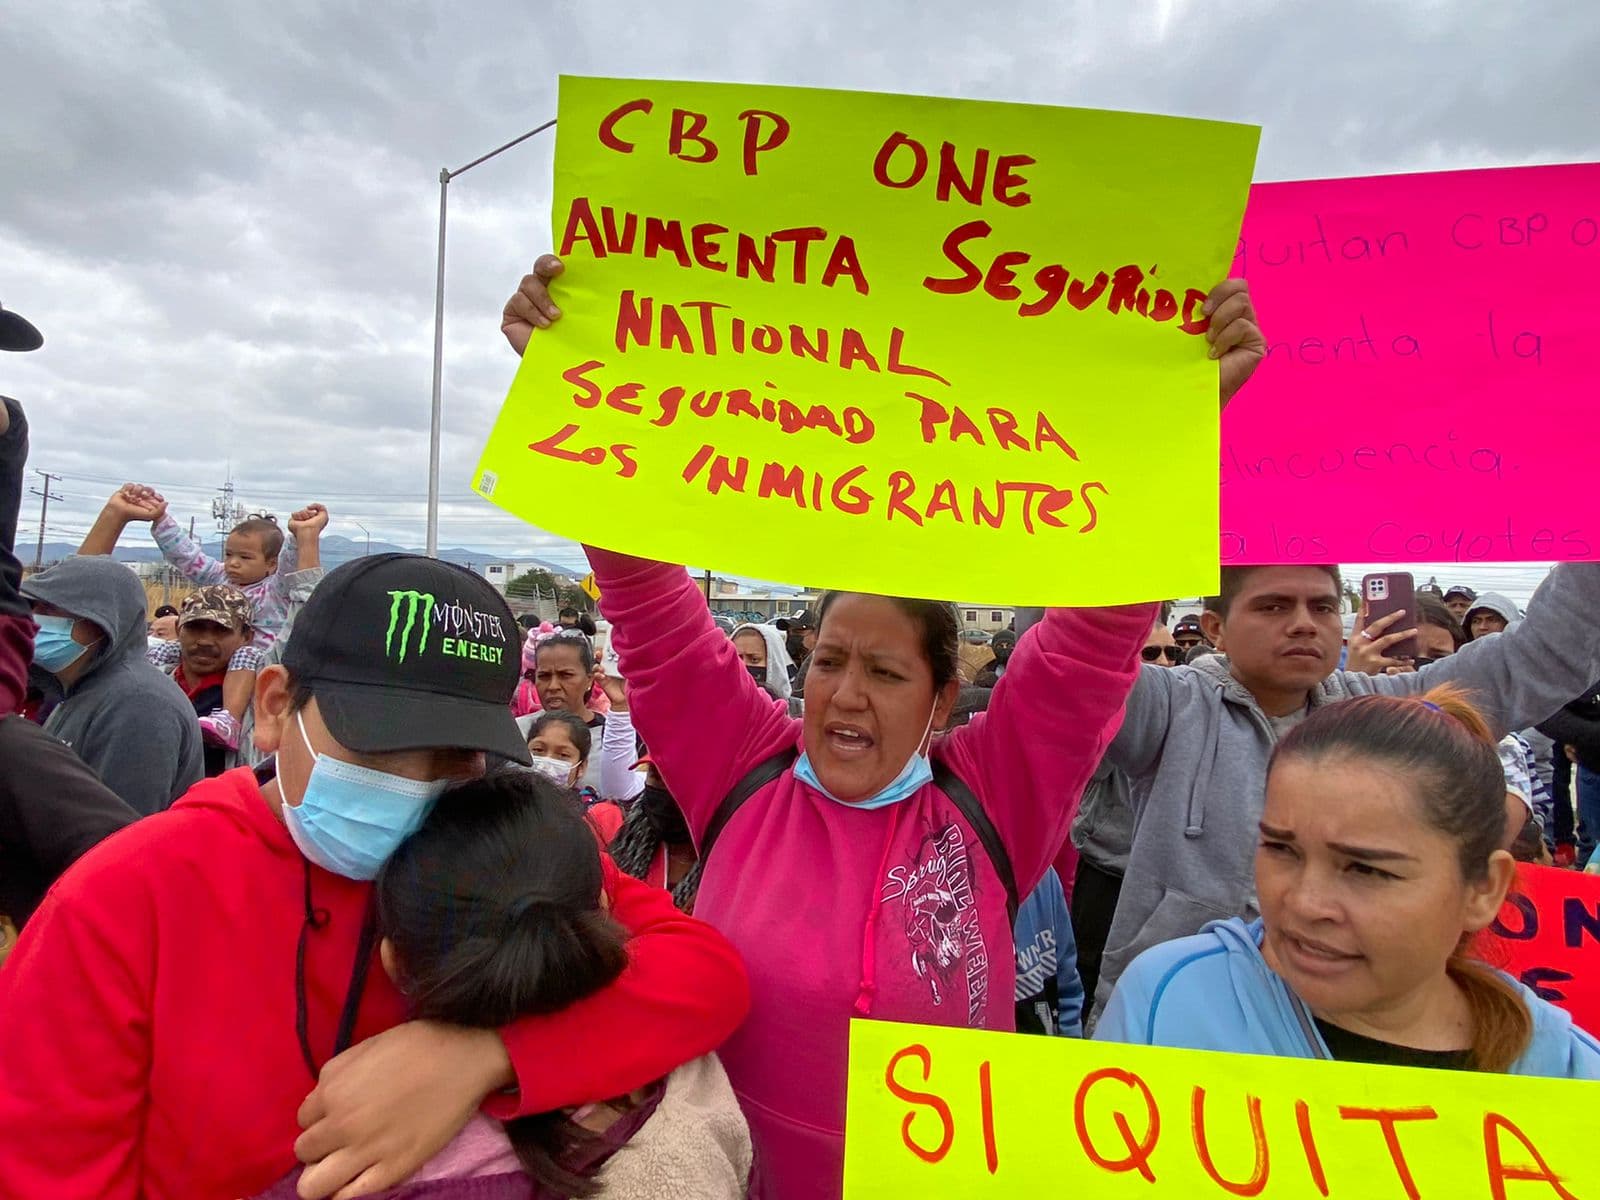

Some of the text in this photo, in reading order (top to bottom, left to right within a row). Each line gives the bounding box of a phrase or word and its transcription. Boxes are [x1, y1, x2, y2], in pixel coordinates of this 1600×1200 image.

[598, 98, 1035, 208] CBP ONE
[559, 197, 870, 296] AUMENTA
[1452, 212, 1549, 249] CBP
[615, 290, 949, 385] NATIONAL
[1488, 309, 1542, 365] la
[905, 391, 1078, 461] PARA
[1272, 522, 1328, 559] los
[1367, 516, 1592, 562] Coyotes
[433, 599, 506, 642] MONSTER
[442, 637, 503, 665] ENERGY
[884, 1043, 1579, 1200] SI QUITA
